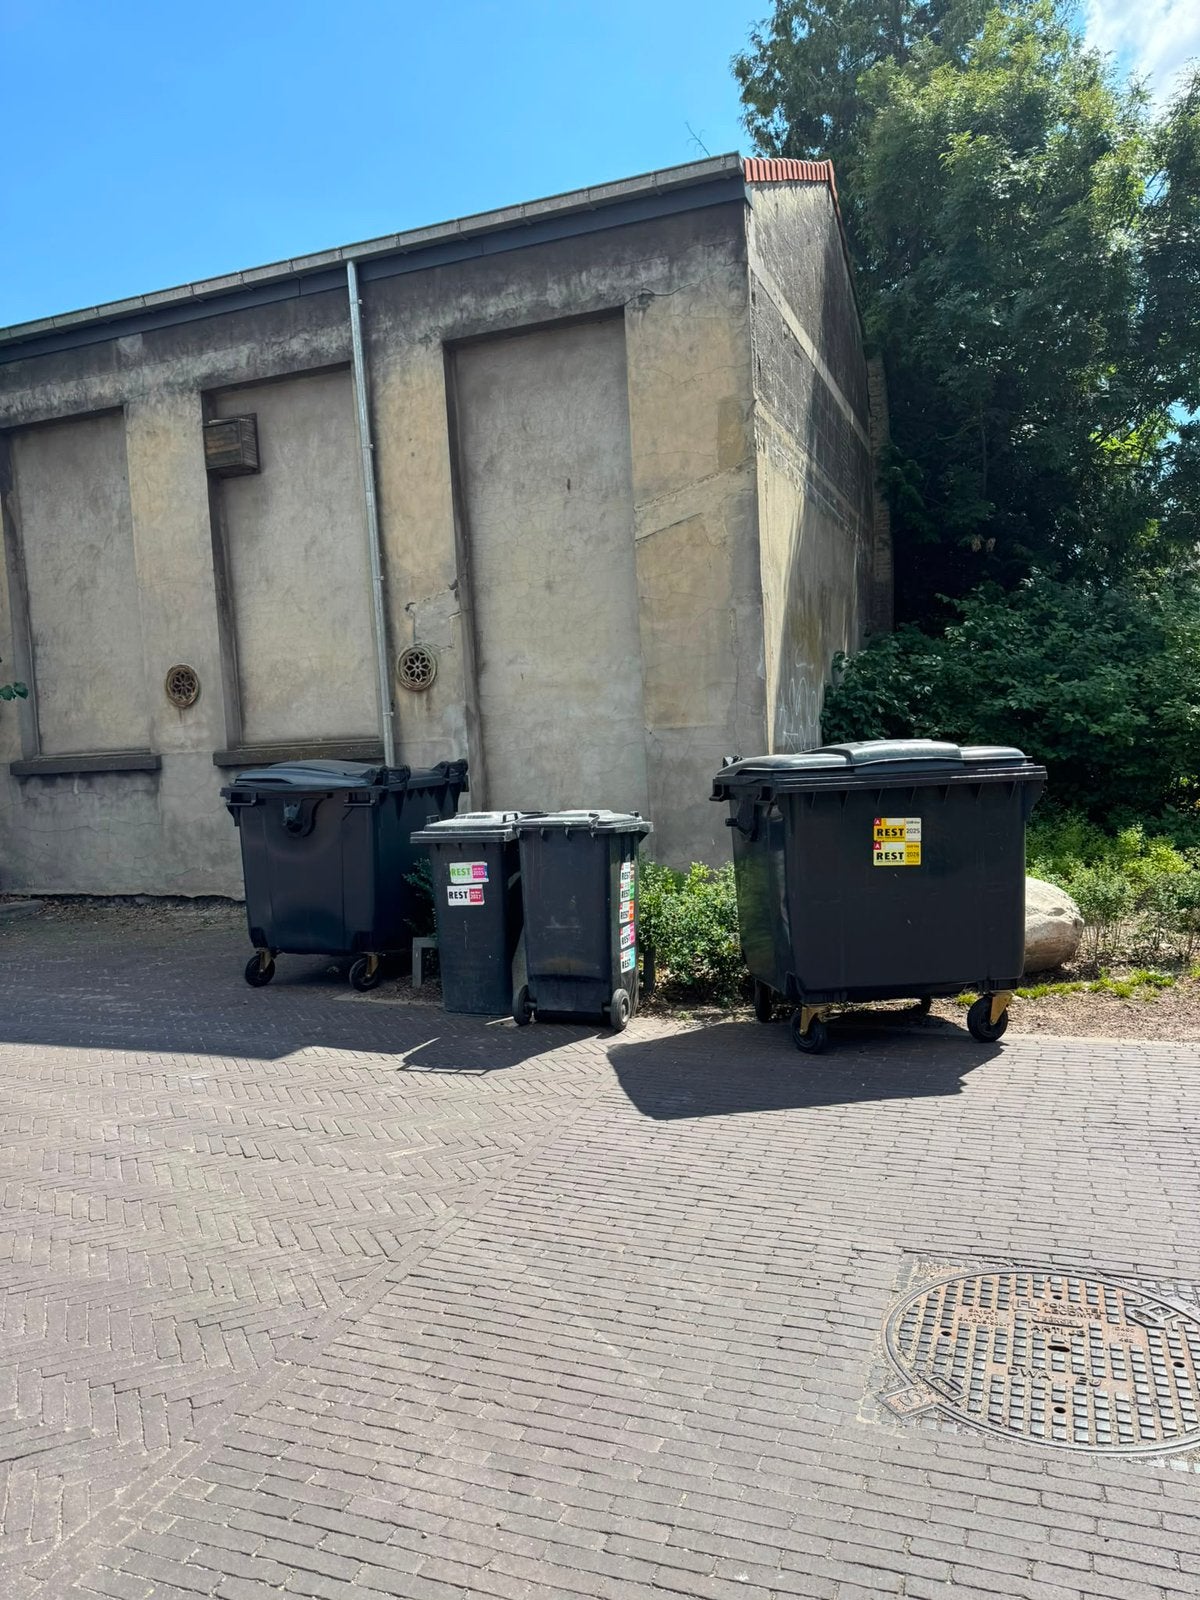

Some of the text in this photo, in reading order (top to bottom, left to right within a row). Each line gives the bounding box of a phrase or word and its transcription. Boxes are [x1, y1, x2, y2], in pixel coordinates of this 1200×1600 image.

[877, 828, 905, 836] REST
[876, 852, 904, 860] REST
[451, 867, 470, 877] REST
[621, 872, 630, 881] REST
[448, 891, 468, 899] REST
[621, 889, 630, 898] REST
[620, 911, 629, 919] REST
[621, 933, 630, 944] REST
[622, 958, 631, 969] REST
[1042, 1302, 1106, 1315] FONDATEL
[1044, 1308, 1102, 1320] LECOMTE
[1008, 1366, 1051, 1381] DWA
